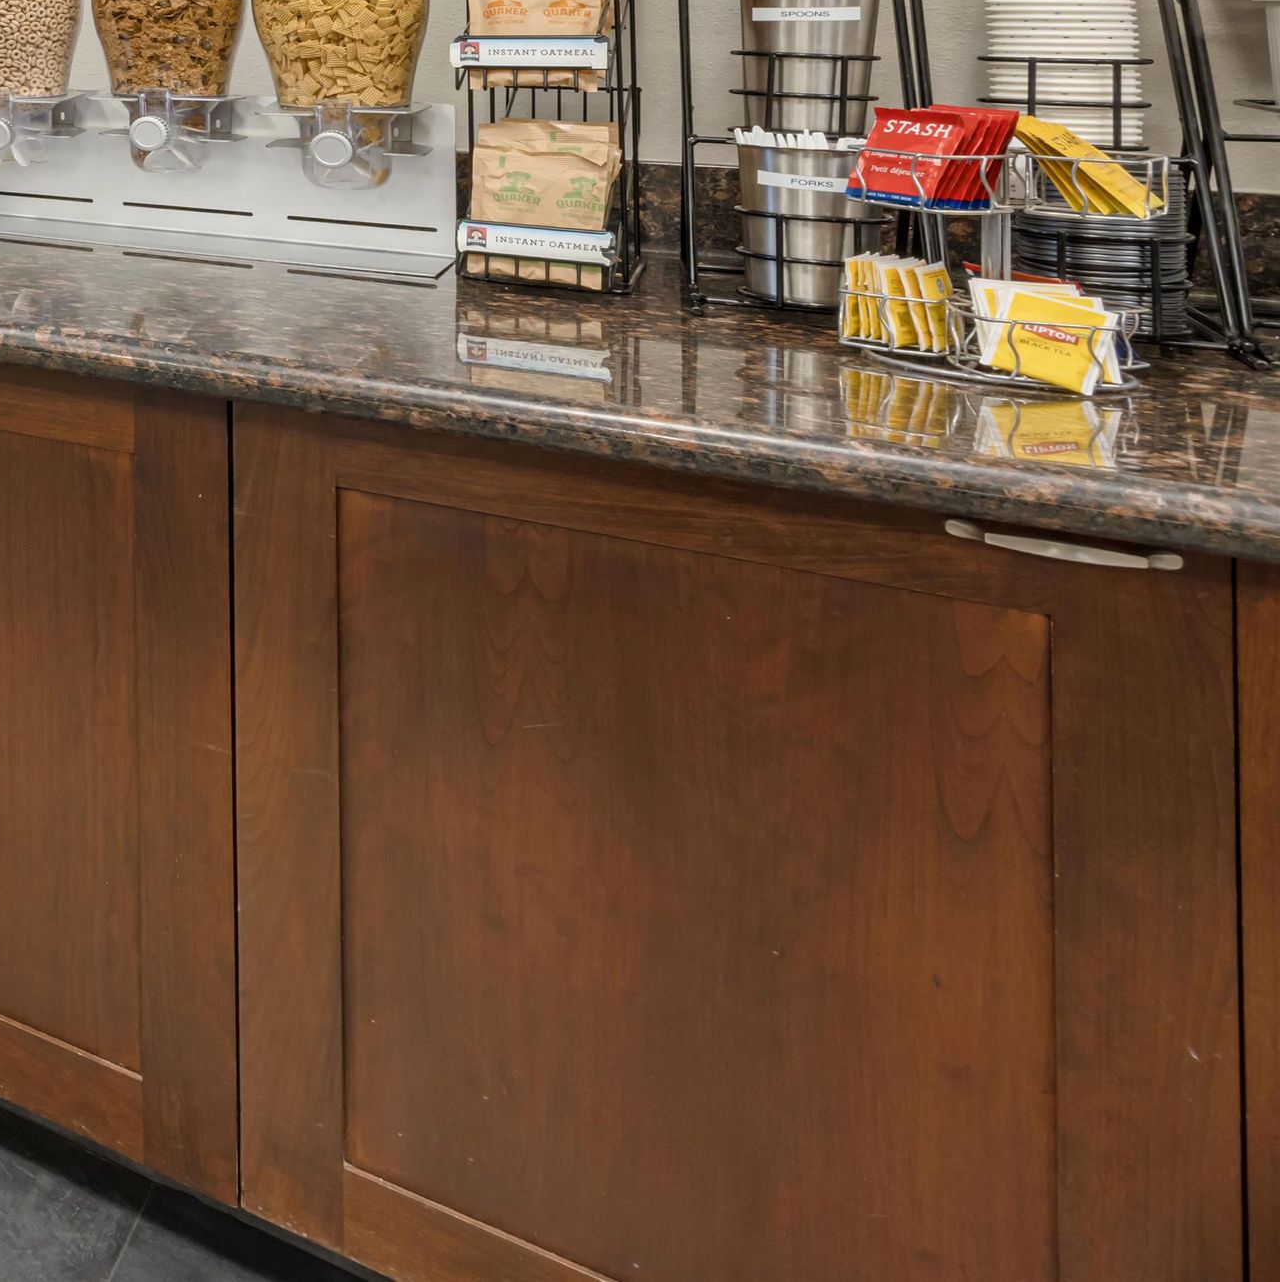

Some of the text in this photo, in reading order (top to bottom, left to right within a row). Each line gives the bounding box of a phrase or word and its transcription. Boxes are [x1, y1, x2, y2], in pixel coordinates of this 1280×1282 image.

[483, 7, 529, 20] QUAKER
[543, 7, 594, 20] QUAKER
[780, 10, 831, 18] SPOONS
[884, 119, 954, 139] STASH
[871, 165, 926, 177] Petit déjeuer
[790, 178, 834, 188] FORKS
[492, 192, 541, 206] QUAKER
[556, 198, 605, 213] QUAKER
[495, 236, 545, 247] INSTANT
[1024, 324, 1078, 344] LIPTON
[1019, 339, 1072, 358] BLACK TEA
